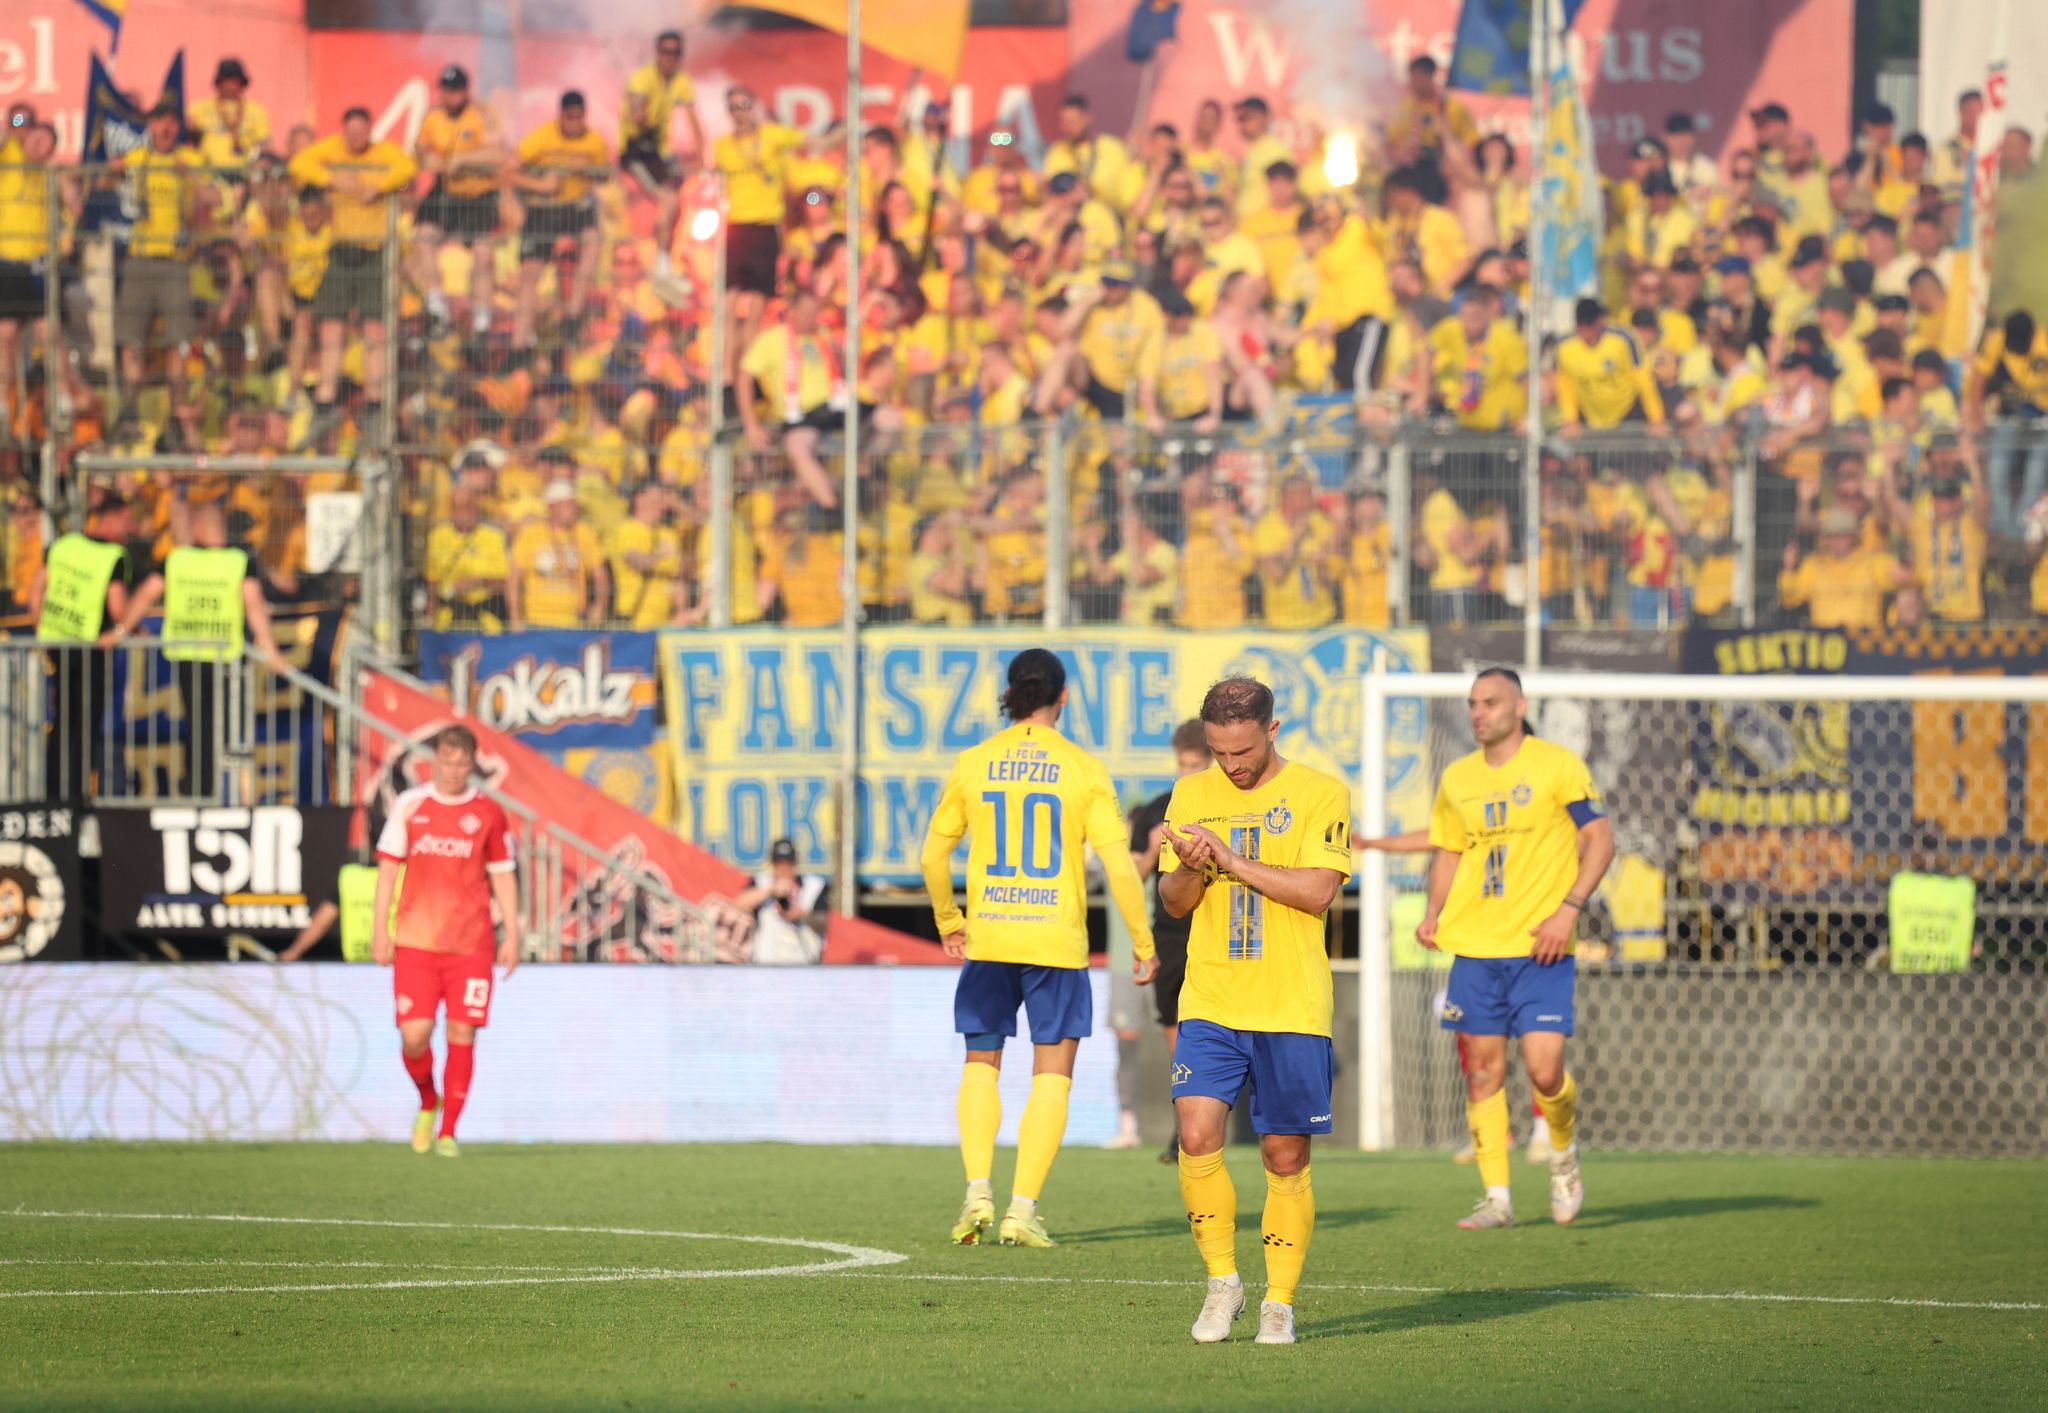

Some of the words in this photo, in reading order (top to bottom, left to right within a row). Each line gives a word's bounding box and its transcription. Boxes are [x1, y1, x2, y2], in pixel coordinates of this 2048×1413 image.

[678, 646, 1172, 750] FANSZNE
[1016, 749, 1028, 759] FC
[1030, 750, 1048, 760] LOK
[988, 761, 1060, 783] LEIPZIG
[1198, 816, 1221, 825] CRAFT
[982, 791, 1062, 878] 10
[982, 885, 1059, 906] MCLEMORE
[463, 977, 489, 1008] 13
